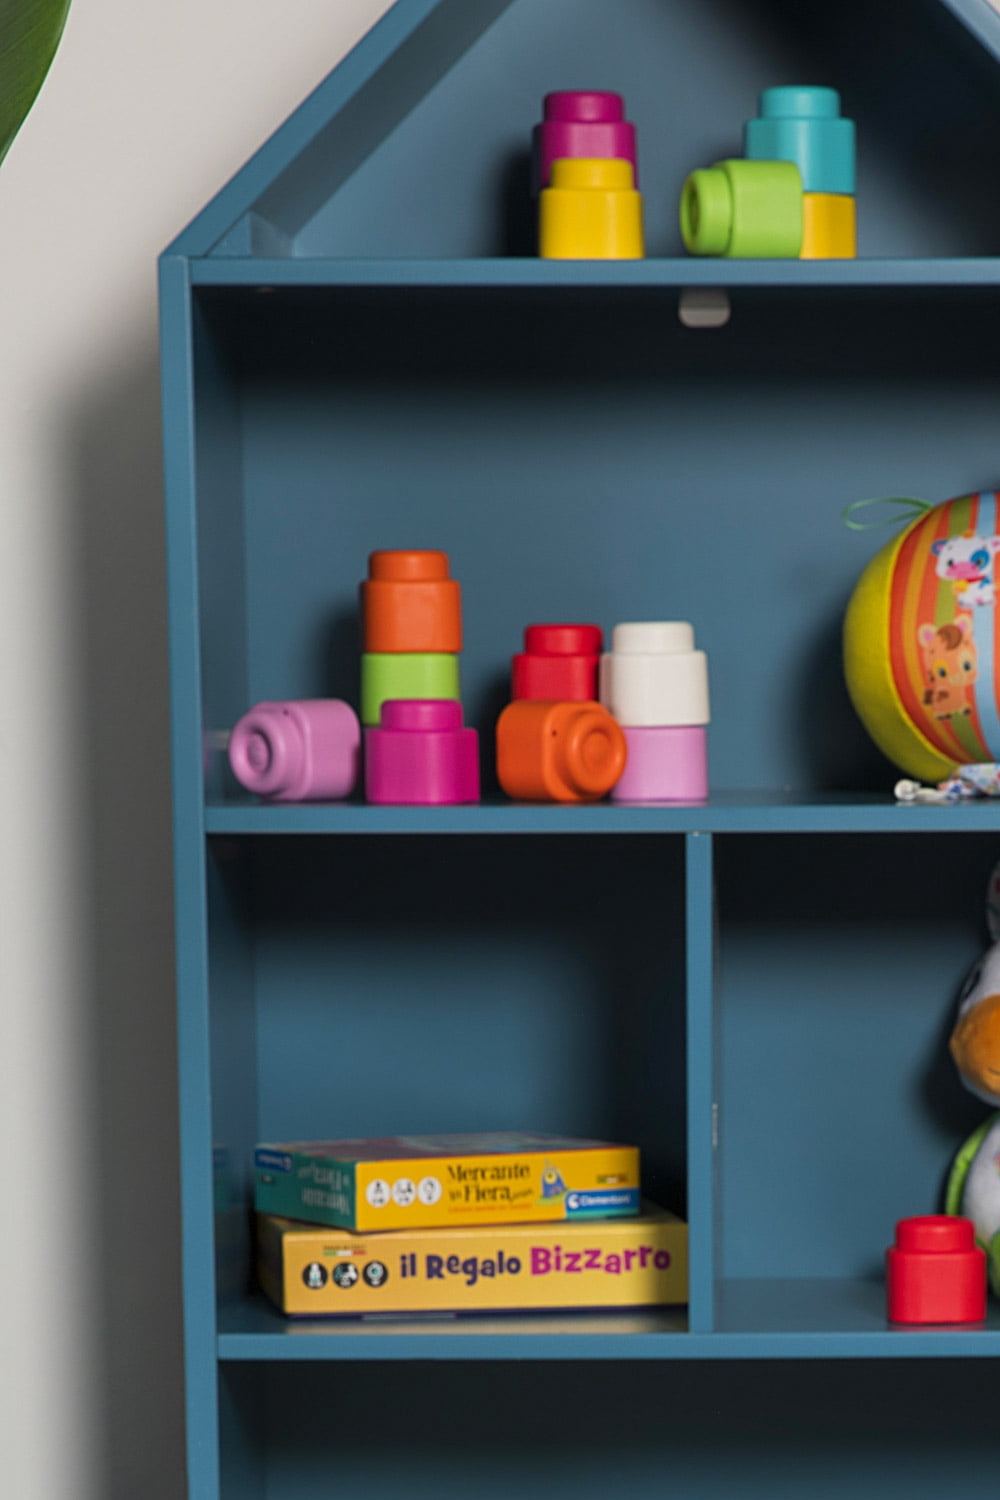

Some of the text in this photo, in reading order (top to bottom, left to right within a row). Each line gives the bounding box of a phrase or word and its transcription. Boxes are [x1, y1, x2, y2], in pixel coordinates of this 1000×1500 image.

[446, 1163, 530, 1183] Mercante
[400, 1245, 672, 1287] il Regalo Bizzarro
